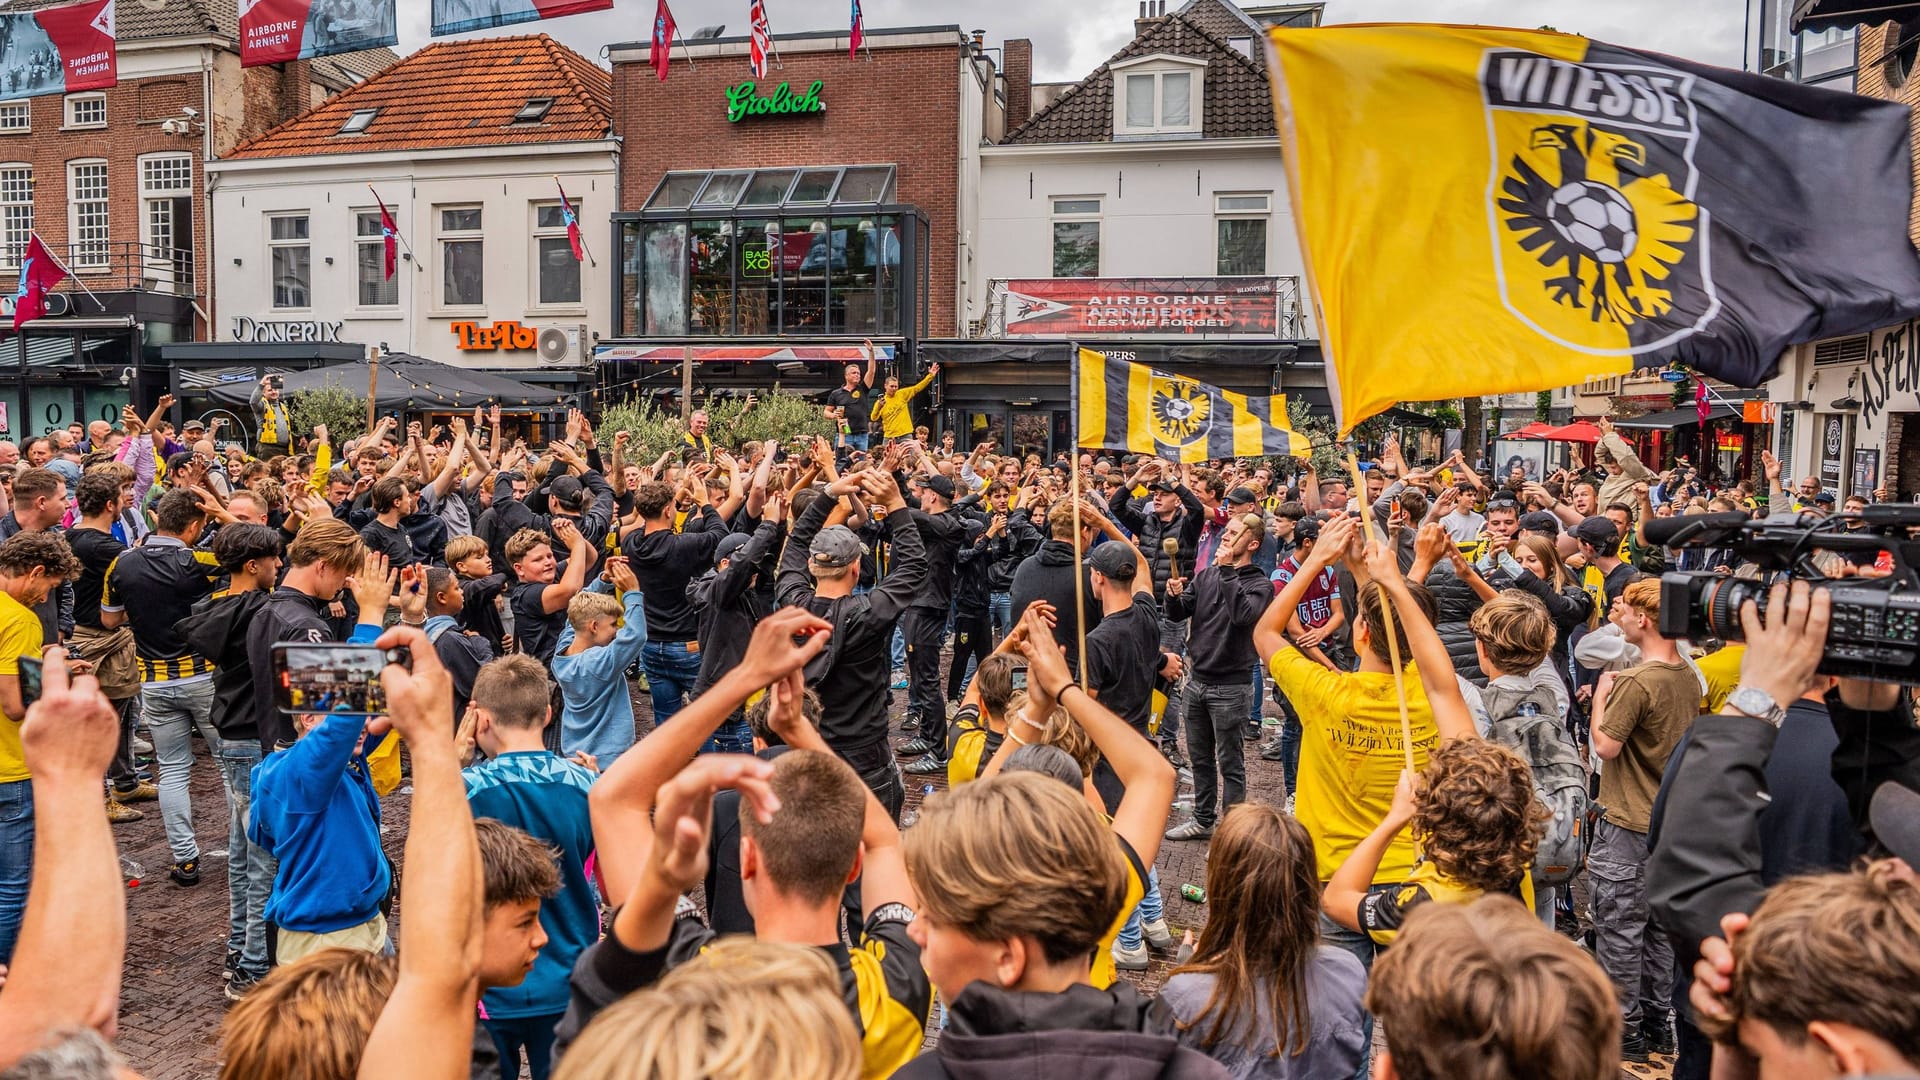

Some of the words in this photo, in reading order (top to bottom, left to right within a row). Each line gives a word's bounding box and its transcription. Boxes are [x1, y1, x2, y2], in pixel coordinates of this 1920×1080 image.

[248, 20, 297, 37] AIRBORNE
[248, 34, 290, 49] ARNHEM
[1498, 57, 1687, 126] VITESSE
[725, 80, 823, 122] Grolsch
[745, 250, 770, 259] BAR
[745, 258, 771, 270] XO
[1087, 295, 1228, 306] AIRBORNE
[1087, 307, 1194, 317] ARNHEM
[1087, 318, 1133, 327] LEST
[1134, 318, 1157, 327] WE
[1159, 318, 1227, 327] FORGET
[1862, 318, 1920, 430] ASPEN
[1310, 596, 1329, 610] BET
[1312, 607, 1331, 621] CITY
